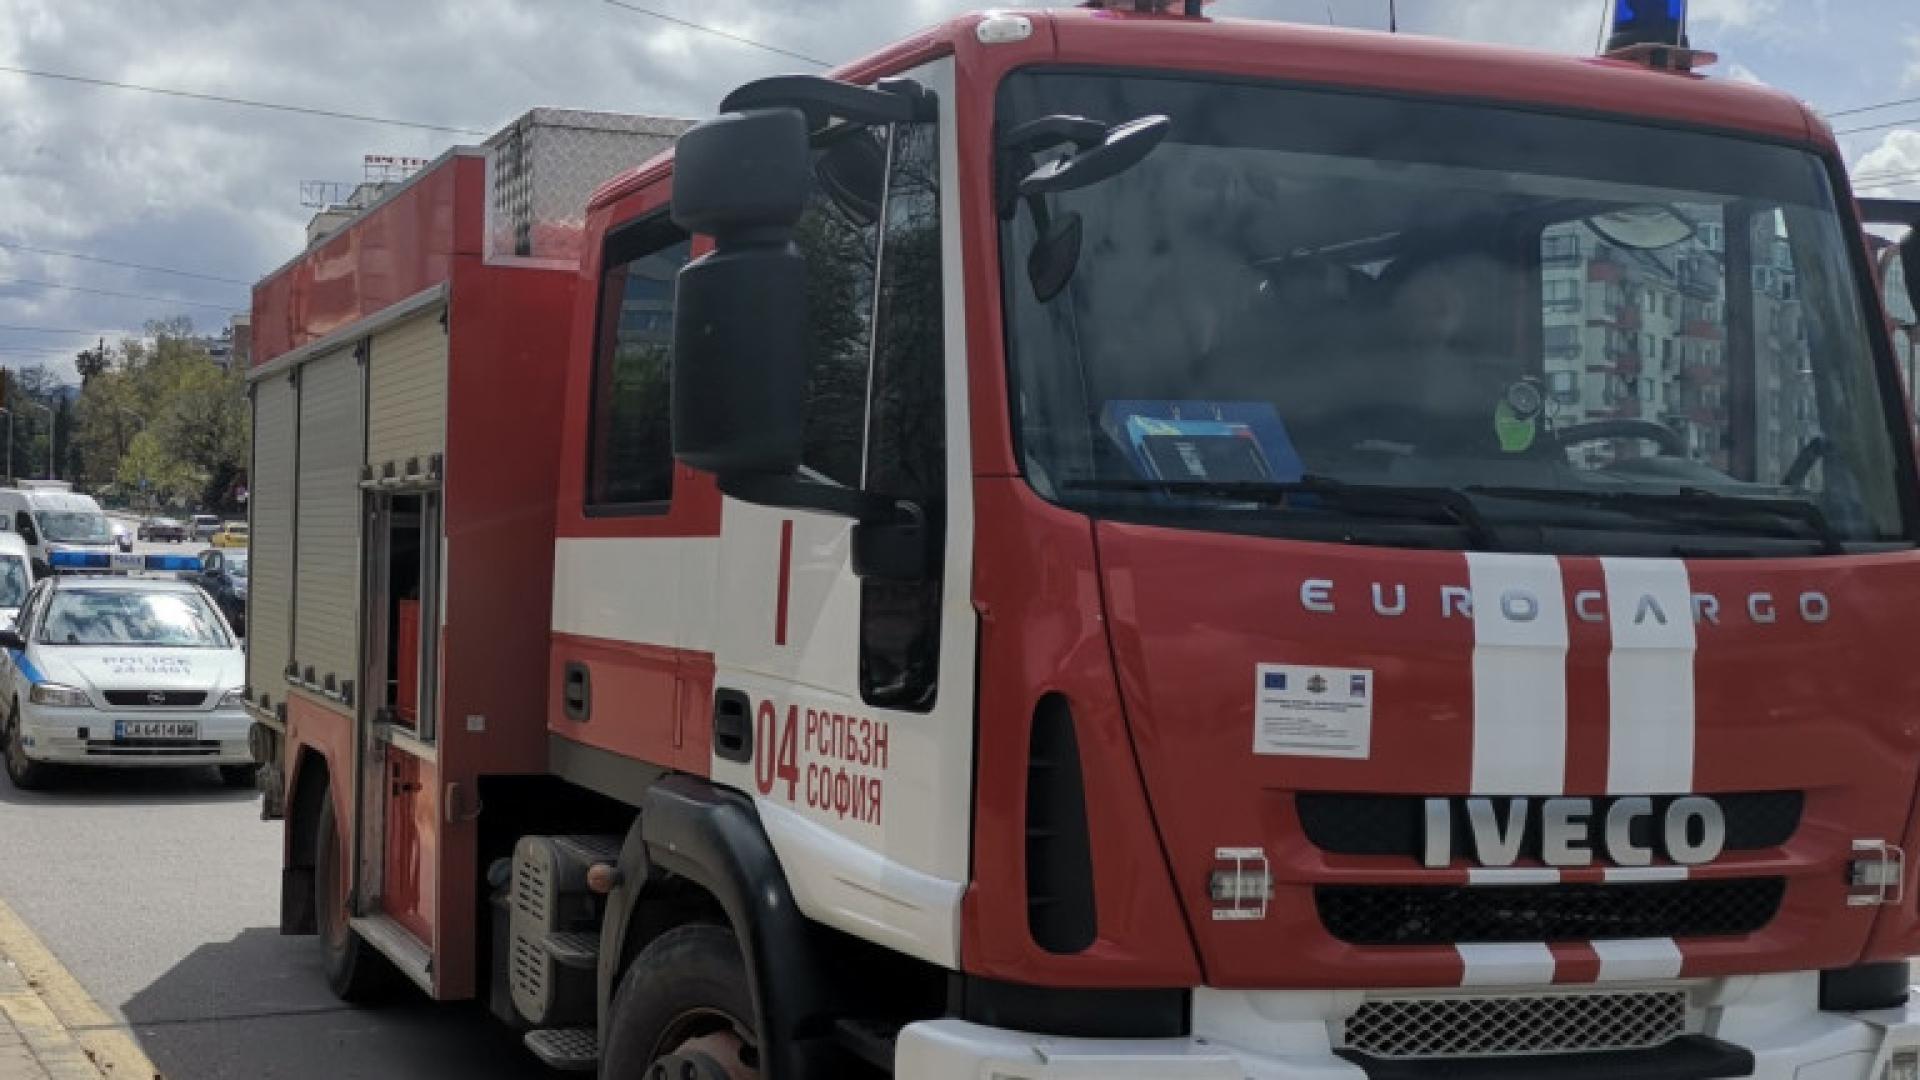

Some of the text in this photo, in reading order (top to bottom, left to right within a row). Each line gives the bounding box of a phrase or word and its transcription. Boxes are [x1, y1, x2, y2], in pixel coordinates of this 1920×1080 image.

[1300, 579, 1830, 625] EUROCARGO
[754, 699, 800, 802] 04
[804, 707, 889, 770] РСПБЗН
[806, 762, 882, 826] СОФИЯ
[1423, 795, 1726, 868] IVECO
